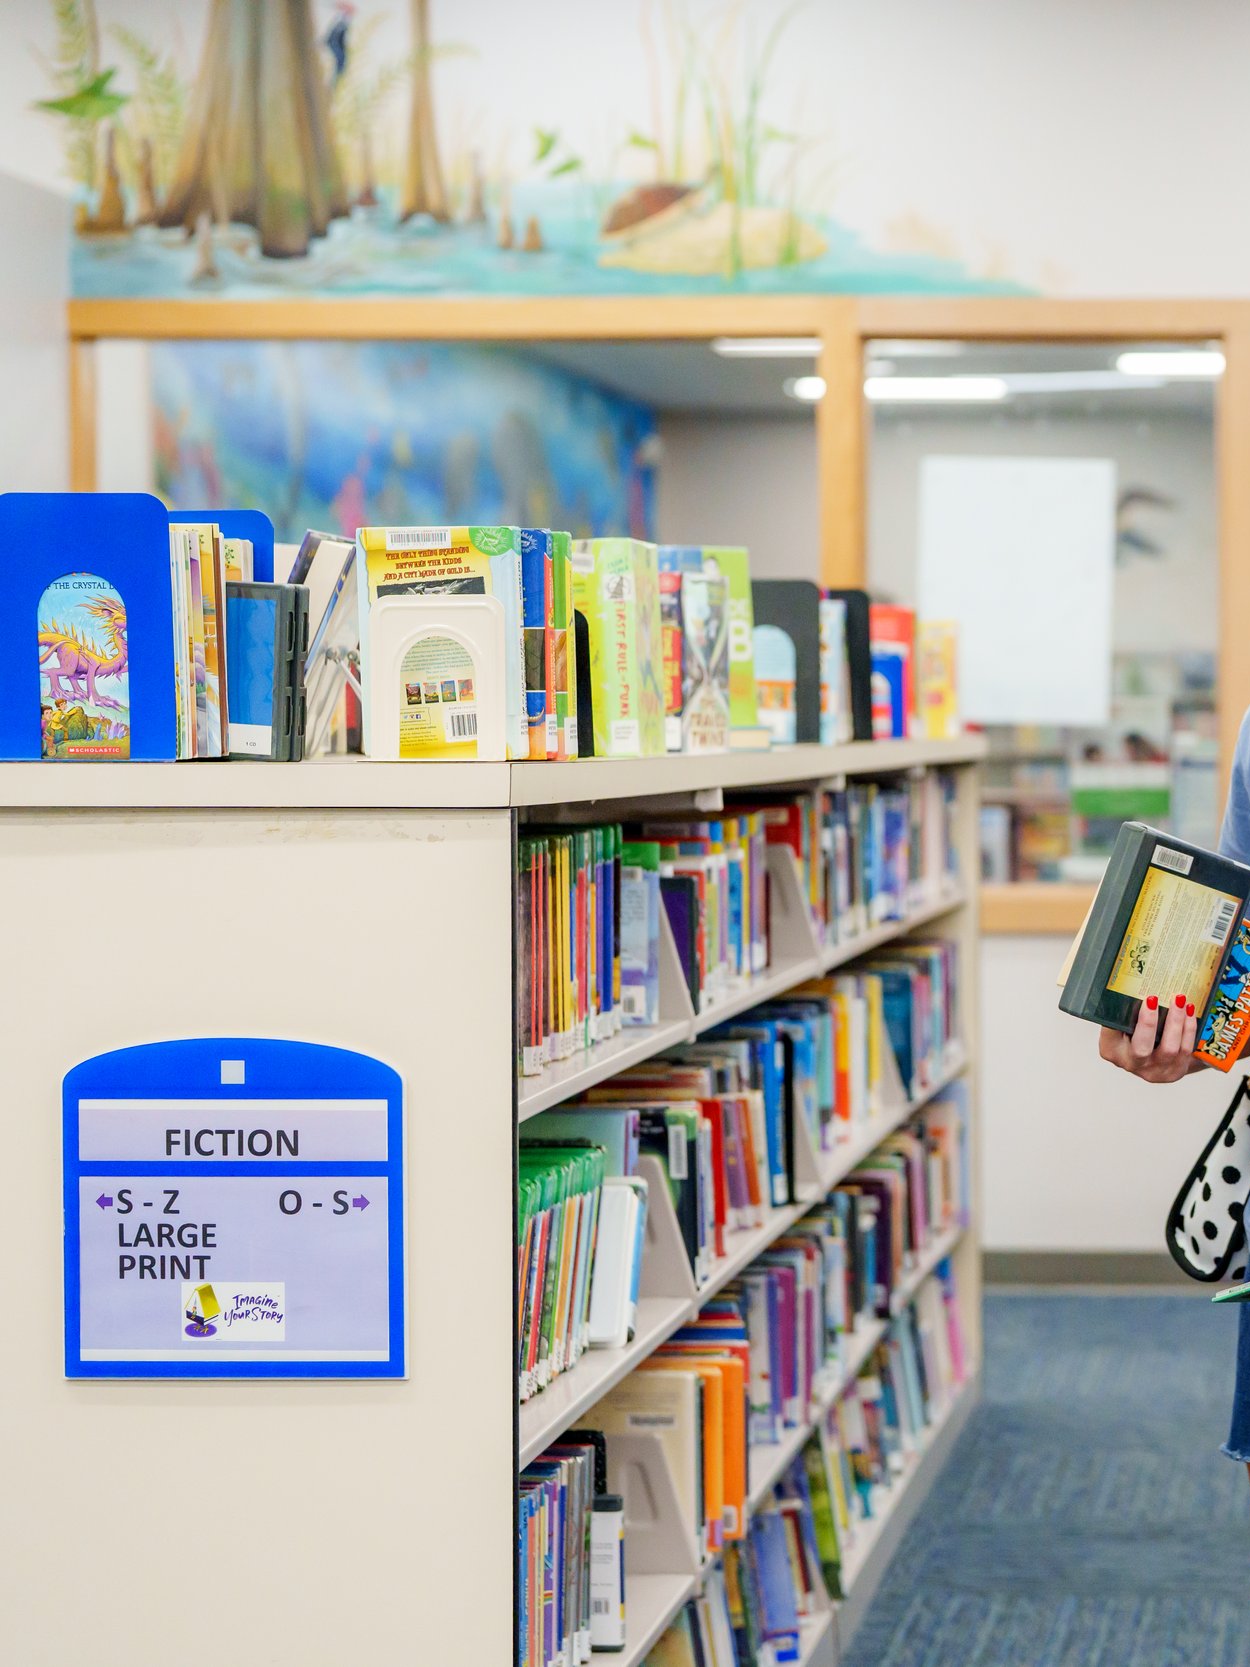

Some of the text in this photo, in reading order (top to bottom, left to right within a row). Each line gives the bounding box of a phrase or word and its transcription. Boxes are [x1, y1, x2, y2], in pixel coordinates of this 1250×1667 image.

[396, 560, 426, 569] BETWEEN
[442, 558, 462, 566] KIDDS
[401, 551, 416, 559] ONLY
[418, 549, 438, 557] THING
[439, 547, 469, 556] STANDING
[418, 570, 436, 578] MADE
[54, 582, 70, 590] THE
[72, 582, 107, 590] CRYSTAL
[1212, 1013, 1244, 1060] JAMES
[1232, 1039, 1240, 1051] AND
[165, 1129, 299, 1157] FICTION
[116, 1190, 132, 1215] S
[162, 1190, 180, 1214] Z
[278, 1190, 302, 1215] O
[332, 1190, 350, 1215] S
[118, 1222, 218, 1248] LARGE
[118, 1254, 212, 1280] PRINT
[251, 1306, 284, 1325] STORY
